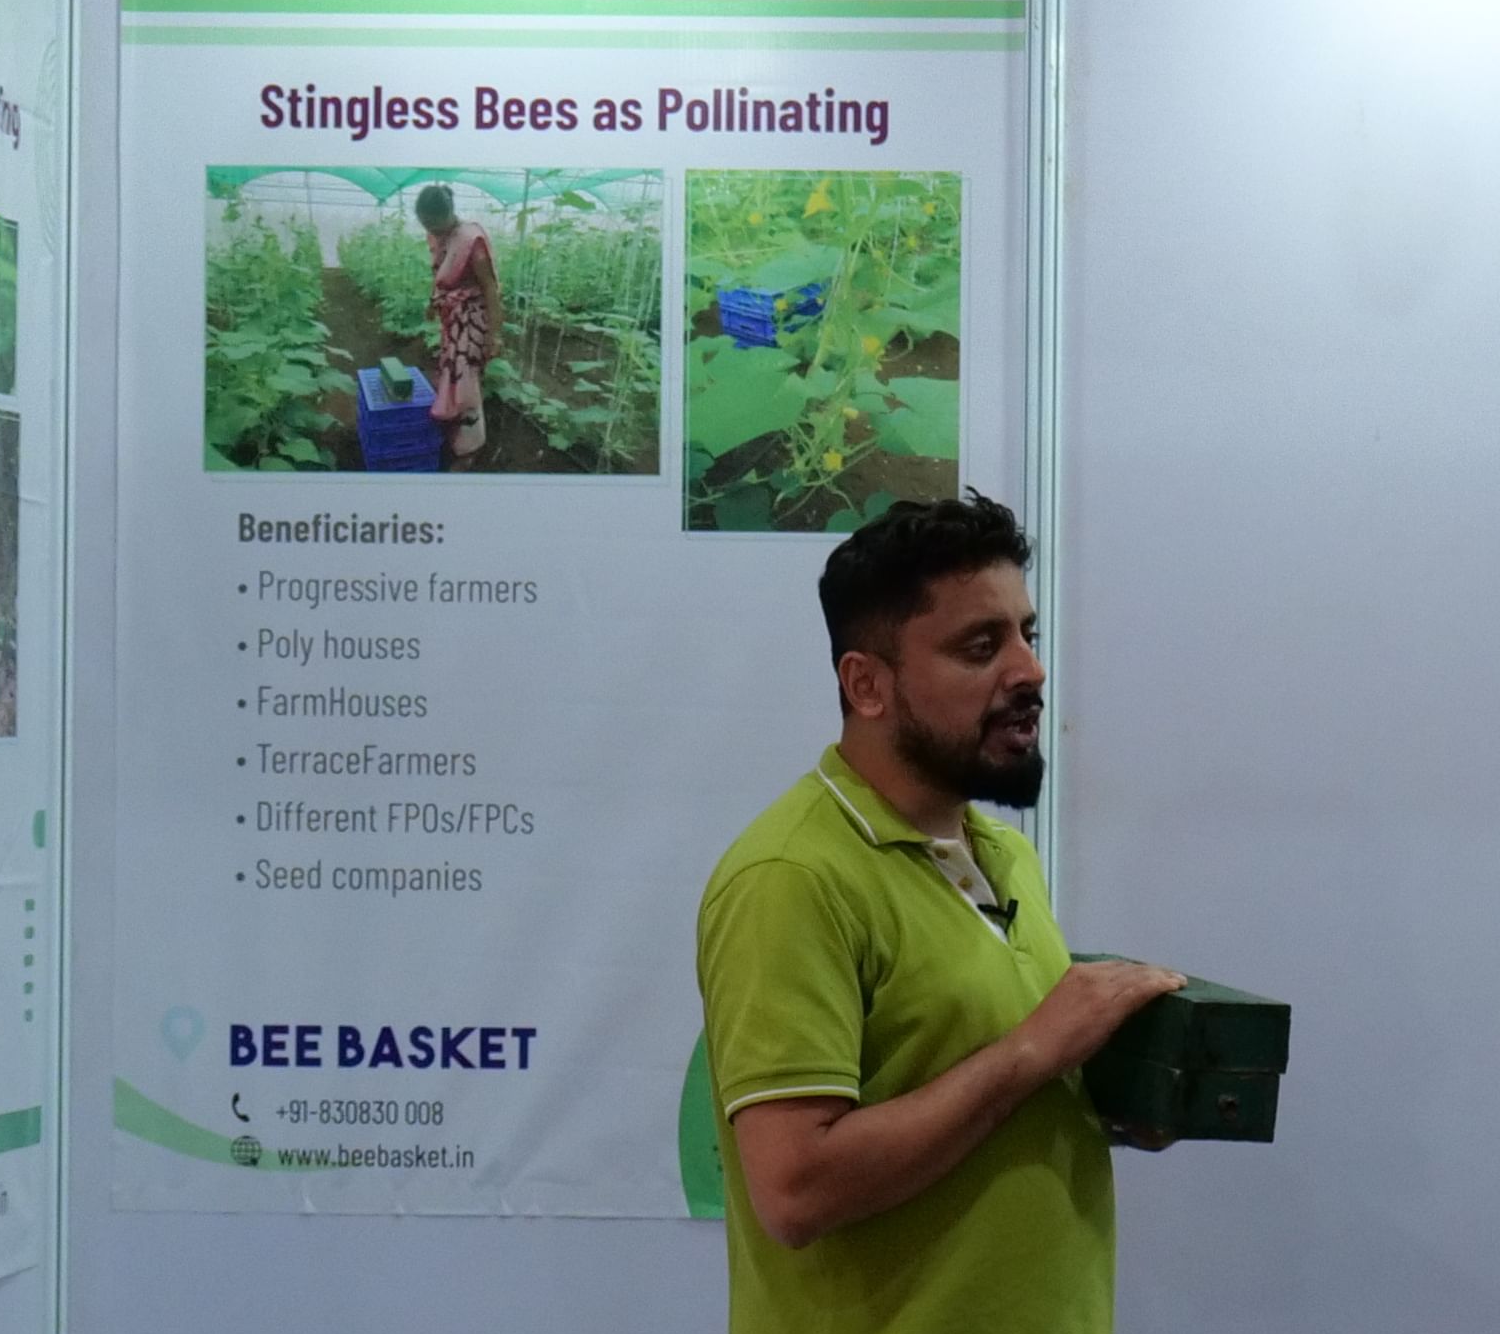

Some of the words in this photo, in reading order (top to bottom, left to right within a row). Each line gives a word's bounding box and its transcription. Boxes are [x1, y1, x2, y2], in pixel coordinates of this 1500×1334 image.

[261, 84, 458, 141] Stingless
[476, 87, 578, 130] Bees
[593, 99, 642, 131] as
[659, 88, 888, 146] Pollinating
[239, 513, 443, 544] Beneficiaries:
[259, 571, 418, 609] Progressive
[429, 573, 537, 603] farmers
[259, 628, 313, 666] Poly
[324, 630, 420, 660] houses
[258, 686, 427, 717] FarmHouses
[257, 744, 475, 776] TerraceFarmers
[257, 801, 377, 832] Different
[388, 803, 534, 834] FPOs/FPCs
[256, 859, 321, 889] Seed
[333, 861, 482, 897] companies
[231, 1025, 322, 1067] BEE
[338, 1026, 536, 1069] BASKET
[276, 1100, 398, 1125] +91-830830
[405, 1101, 444, 1125] 008
[277, 1142, 474, 1170] www.beebasket.in
